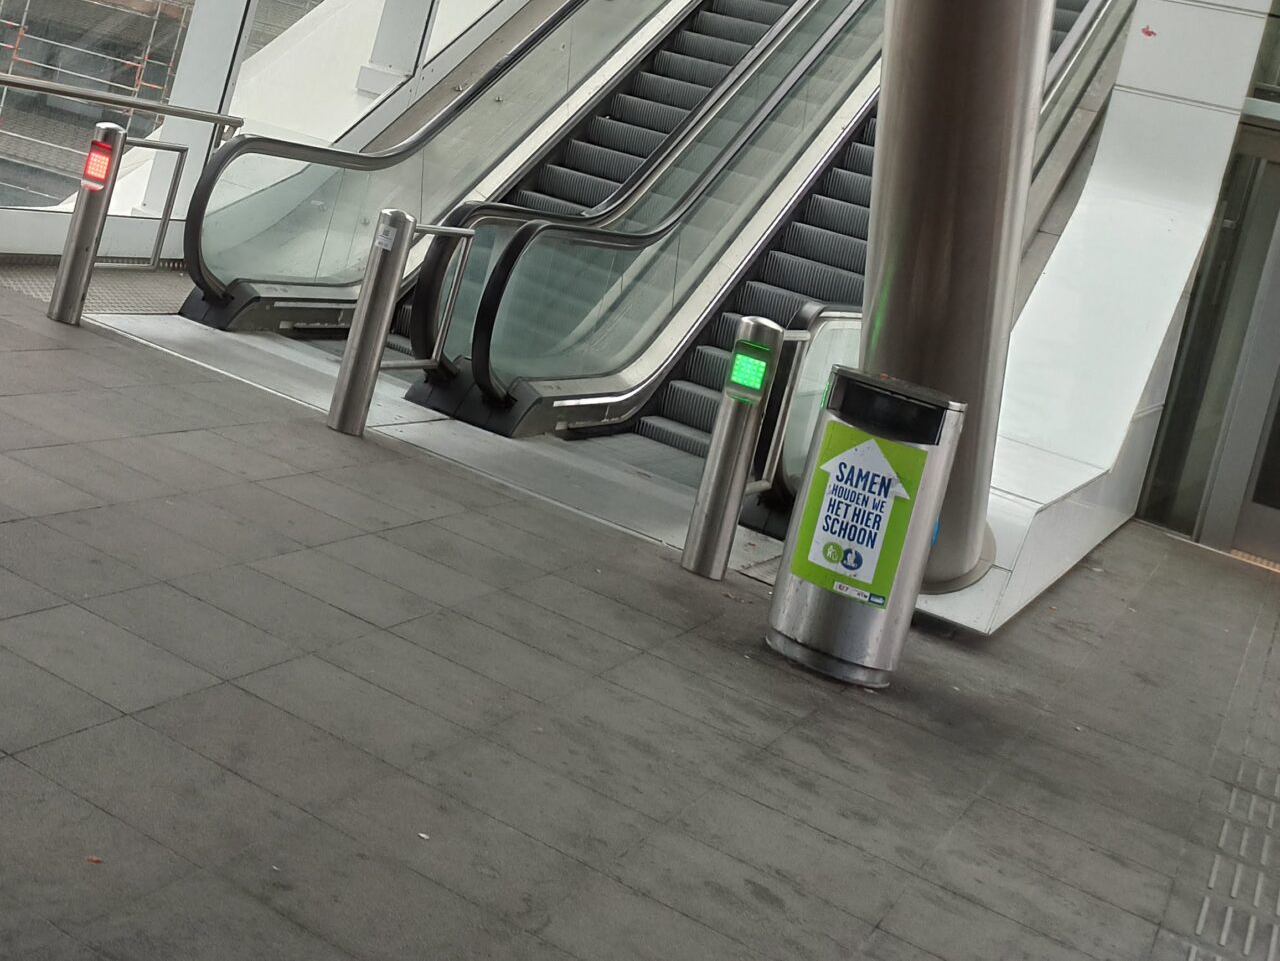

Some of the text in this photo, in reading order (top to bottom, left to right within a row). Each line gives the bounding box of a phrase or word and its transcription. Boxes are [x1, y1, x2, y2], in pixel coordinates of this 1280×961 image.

[835, 461, 893, 499] SAMEN
[826, 497, 882, 531] HET HIER
[831, 483, 887, 514] HOUDEN WE
[822, 514, 878, 550] SCHOON
